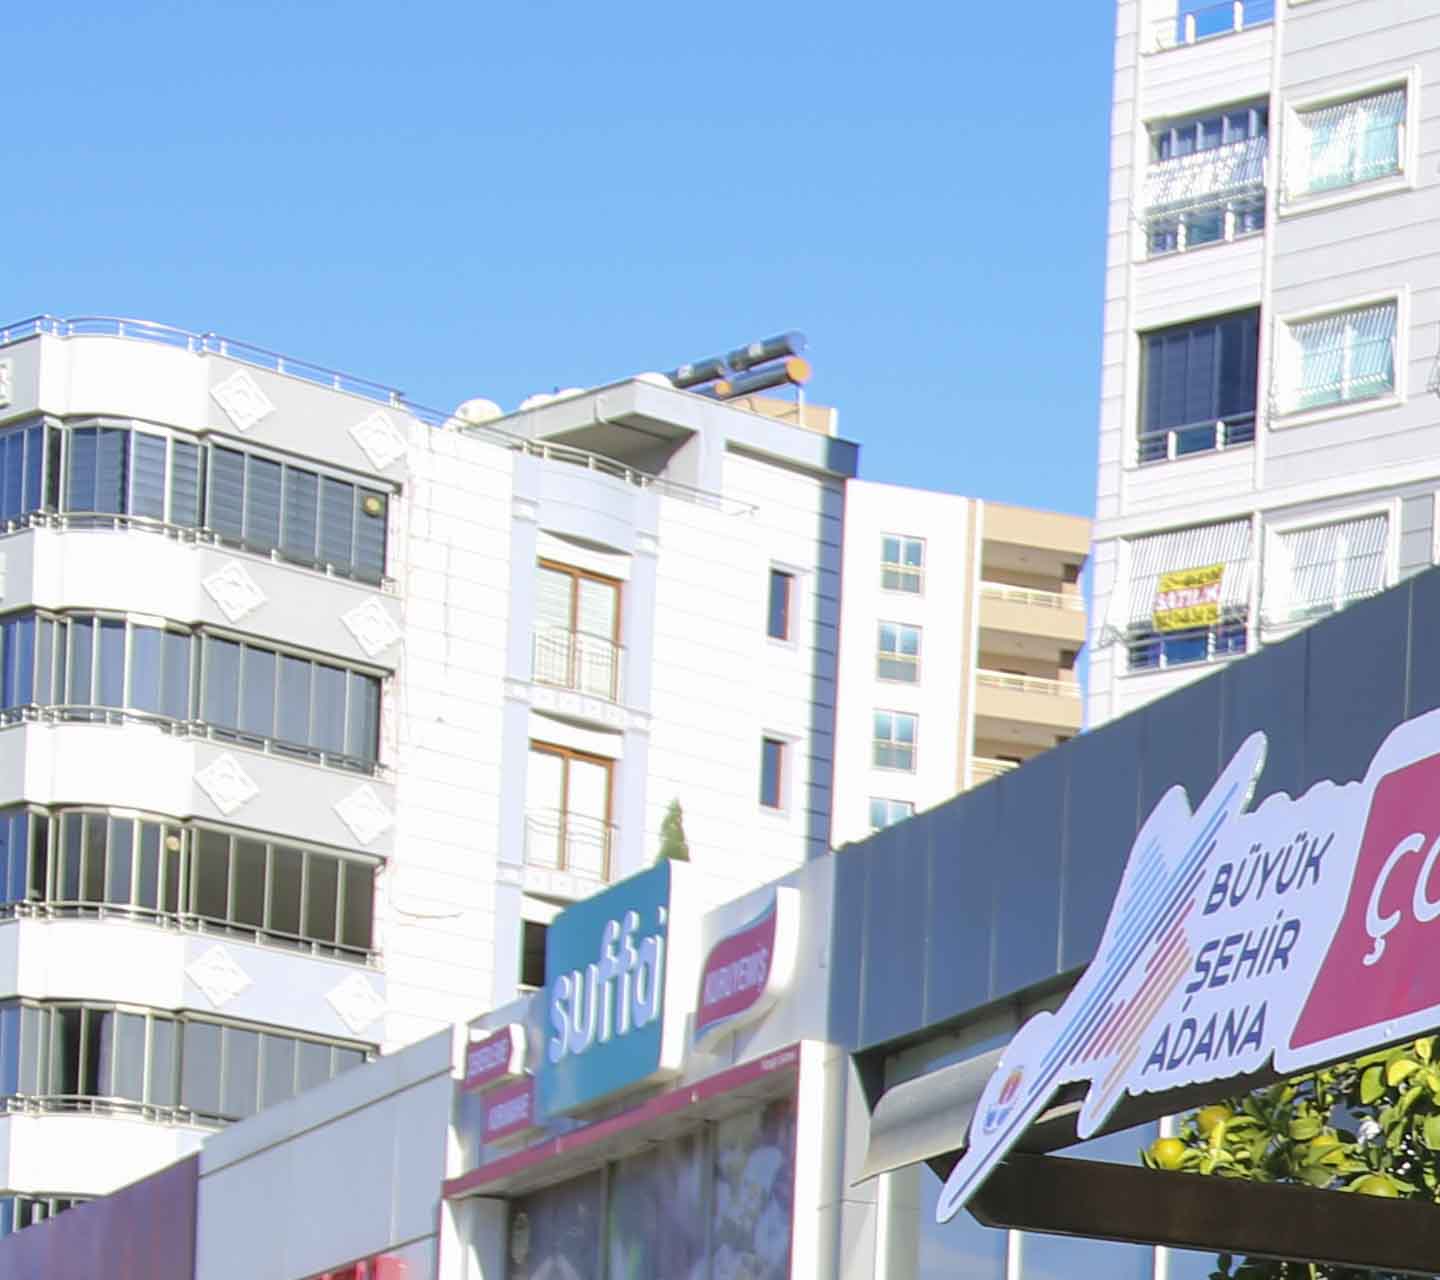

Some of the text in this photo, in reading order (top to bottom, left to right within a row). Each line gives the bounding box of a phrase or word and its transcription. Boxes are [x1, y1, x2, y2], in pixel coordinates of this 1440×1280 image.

[1203, 832, 1334, 916] BÜYÜK
[1183, 910, 1300, 1011] ŞEHİR
[1142, 1001, 1267, 1074] ADANA
